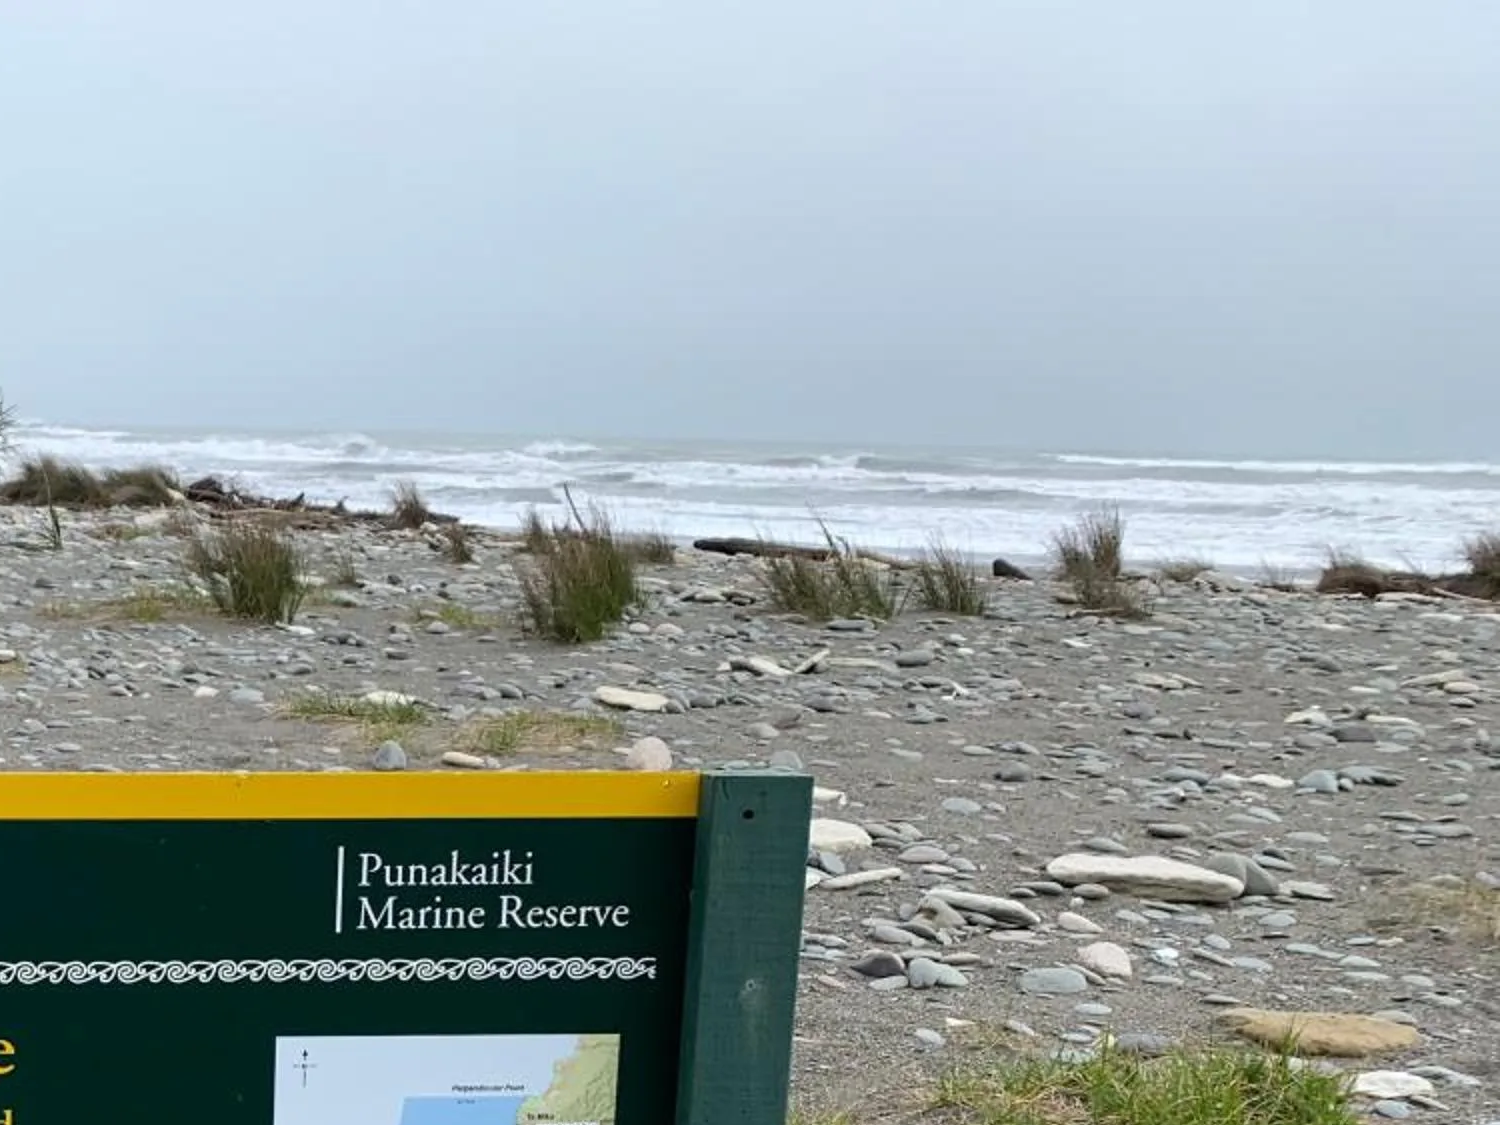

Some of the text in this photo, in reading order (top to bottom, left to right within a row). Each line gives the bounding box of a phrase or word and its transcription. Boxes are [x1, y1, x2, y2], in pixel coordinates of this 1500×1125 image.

[358, 849, 533, 887] Punakaiki
[356, 894, 630, 930] Marine Reserve
